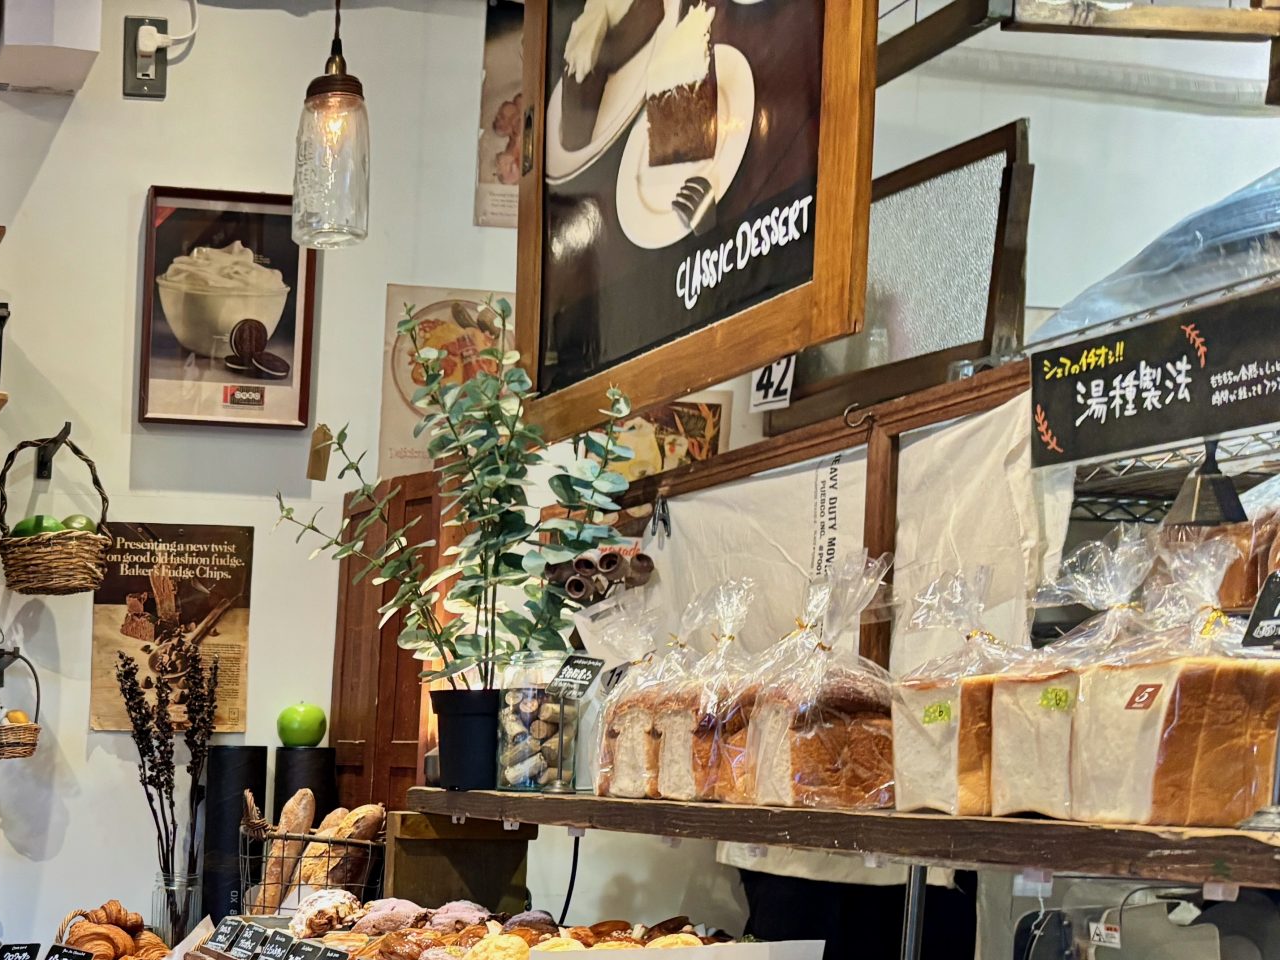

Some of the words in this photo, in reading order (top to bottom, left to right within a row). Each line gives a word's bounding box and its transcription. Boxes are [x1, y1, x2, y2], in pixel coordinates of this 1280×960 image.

[675, 238, 734, 310] CLASSIC
[735, 194, 813, 270] DESSERT
[755, 355, 792, 400] 42
[1075, 354, 1192, 428] 湯種製法
[828, 496, 838, 531] DUTY
[106, 554, 122, 563] on
[122, 551, 150, 564] good
[211, 553, 245, 568] fudge.
[115, 537, 177, 553] Presenting
[185, 543, 209, 552] new
[210, 541, 236, 553] twist
[161, 564, 195, 579] Fudge
[195, 566, 232, 580] Chips.
